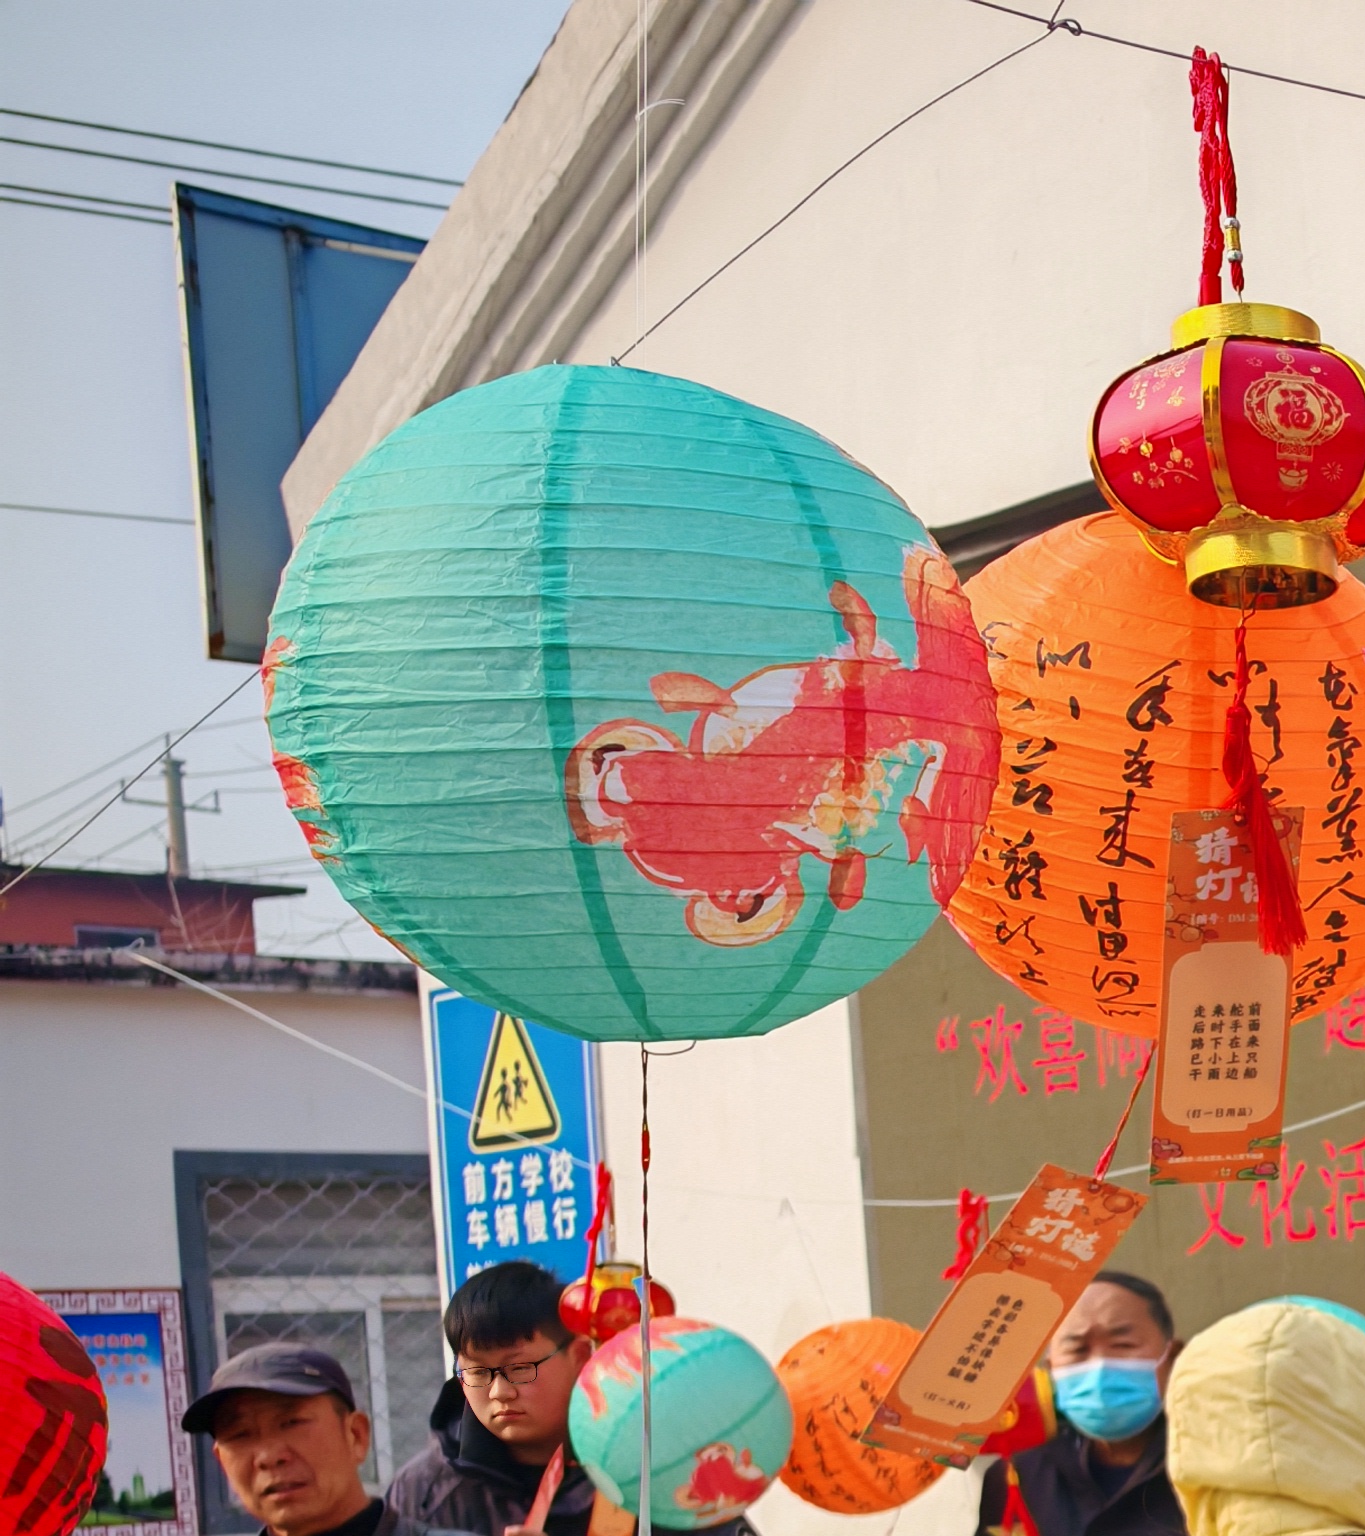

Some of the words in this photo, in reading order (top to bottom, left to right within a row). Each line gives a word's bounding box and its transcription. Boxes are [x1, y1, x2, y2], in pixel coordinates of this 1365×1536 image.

[1195, 826, 1238, 866] 猜
[1207, 1003, 1226, 1081] 来时下小雨
[1224, 1003, 1245, 1081] 舵手在上边
[1243, 1001, 1262, 1080] 前面来只船
[462, 1148, 574, 1206] 前方学校
[466, 1196, 578, 1250] 车辆慢行
